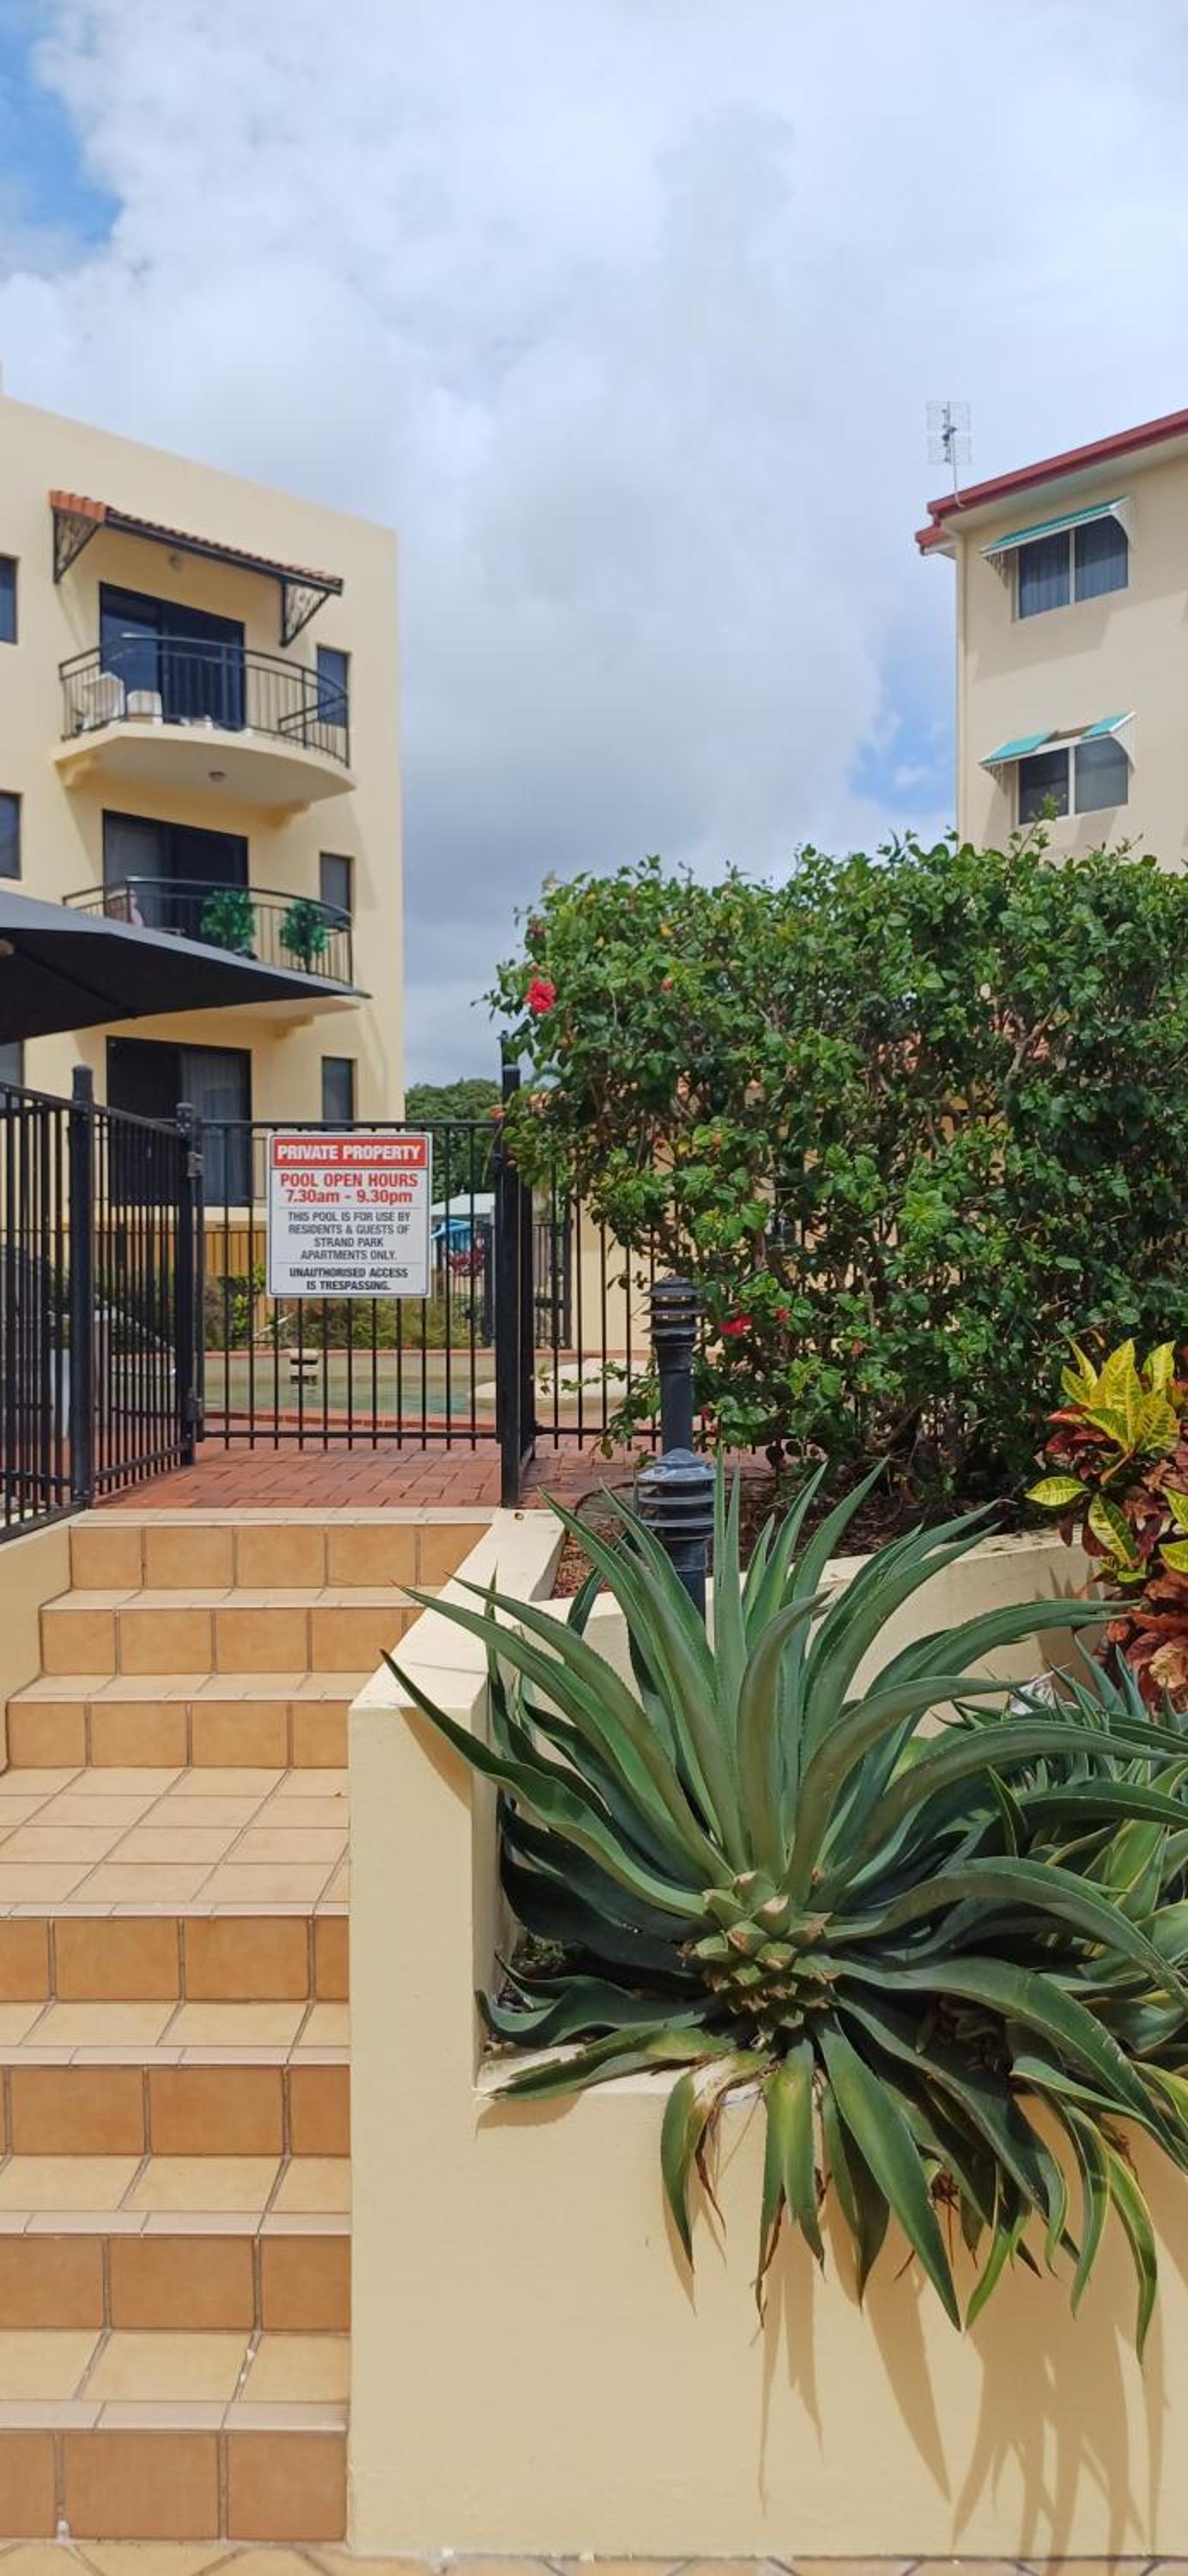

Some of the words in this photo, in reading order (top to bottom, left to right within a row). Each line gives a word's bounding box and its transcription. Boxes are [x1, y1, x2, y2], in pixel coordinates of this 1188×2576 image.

[277, 1145, 338, 1160] PRIVATE
[342, 1145, 421, 1160] PROPERTY
[281, 1174, 318, 1187] POOL
[324, 1174, 362, 1187] OPEN
[368, 1174, 418, 1187] HOURS
[287, 1190, 339, 1202] 7.30am
[356, 1190, 412, 1206] 9.30pm
[288, 1212, 309, 1221] THIS
[312, 1212, 337, 1221] POOL
[342, 1212, 350, 1221] IS
[354, 1212, 373, 1221] FOR
[376, 1212, 394, 1221] USE
[397, 1212, 410, 1221] BY
[288, 1224, 342, 1235] RESIDENTS
[345, 1224, 353, 1235] &
[356, 1224, 393, 1235] GUESTS
[397, 1224, 410, 1235] OF
[314, 1237, 354, 1247] STRAND
[358, 1237, 384, 1247] PARK
[301, 1250, 367, 1260] APARTMENTS
[371, 1250, 397, 1261] ONLY.
[289, 1268, 366, 1278] UNAUTHORISED
[369, 1268, 408, 1278] ACCESS
[306, 1281, 316, 1290] IS
[320, 1281, 391, 1291] TRESPASSING.
